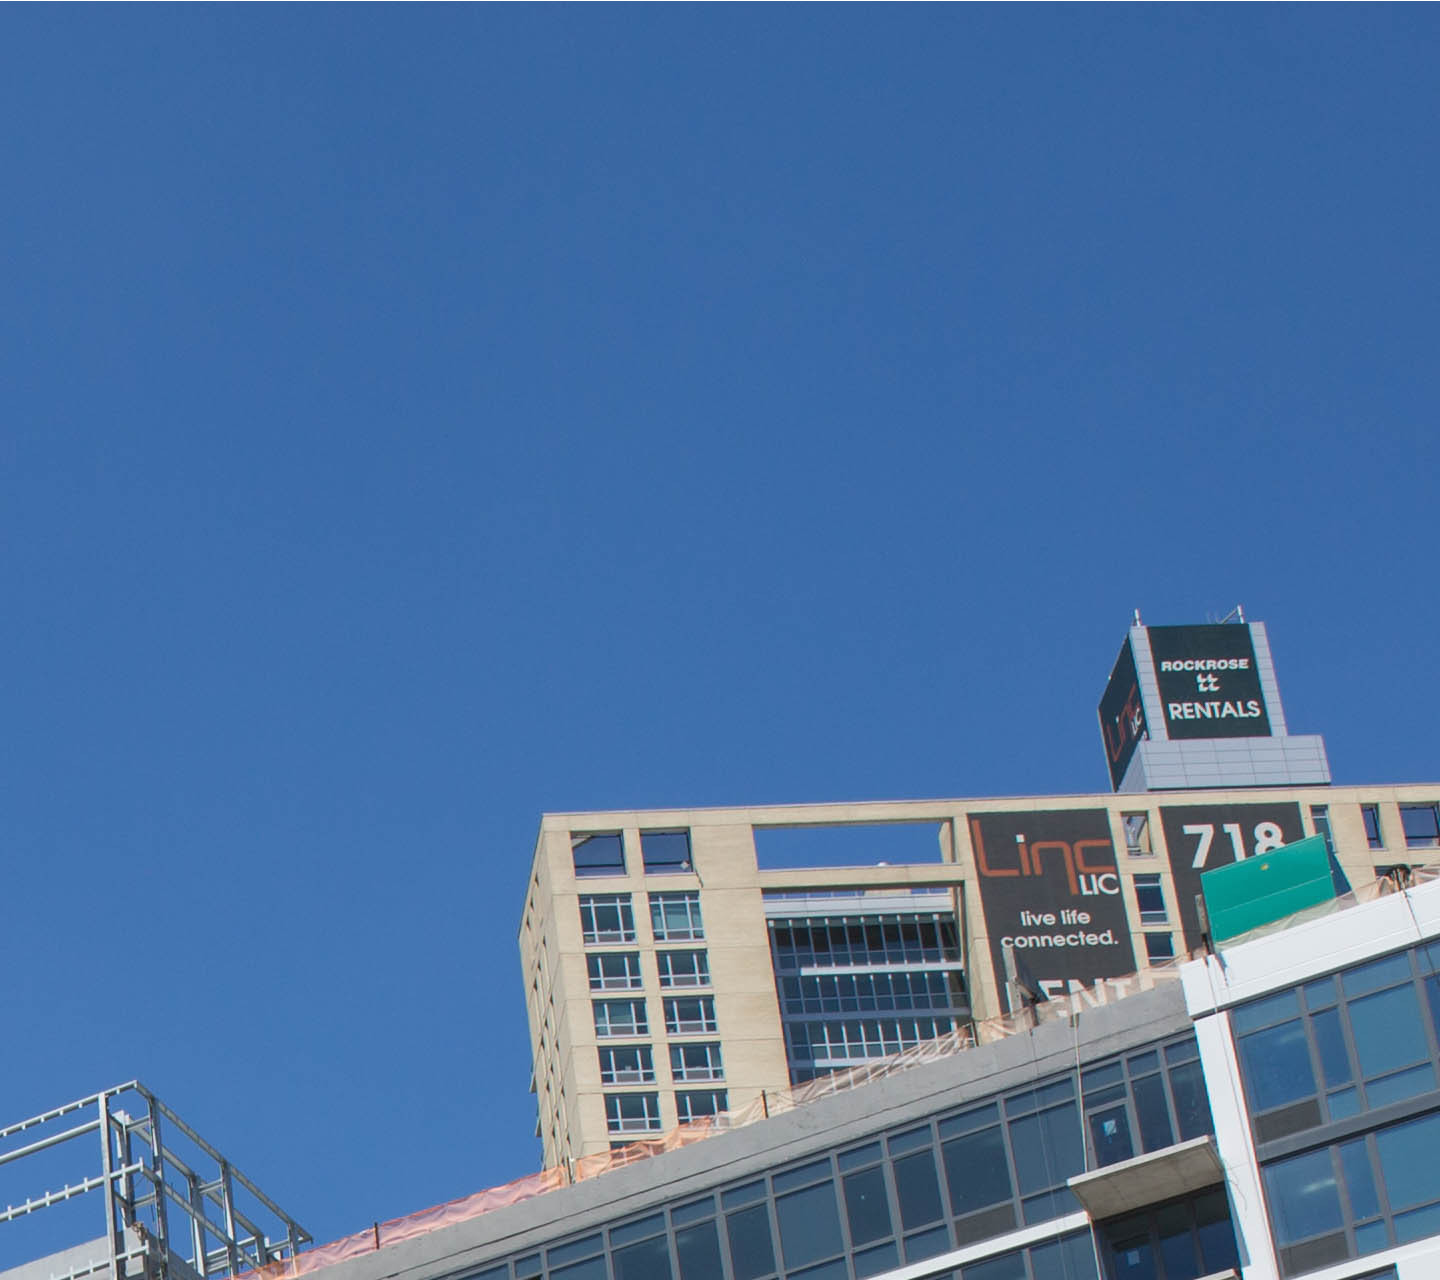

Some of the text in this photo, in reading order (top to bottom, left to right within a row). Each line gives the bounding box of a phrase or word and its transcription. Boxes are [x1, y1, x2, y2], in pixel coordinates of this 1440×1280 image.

[1161, 659, 1249, 672] ROCKROSE
[1168, 700, 1261, 720] RENTALS
[1183, 821, 1285, 869] 718
[1078, 873, 1120, 896] LIC
[1020, 909, 1091, 926] live life
[1000, 929, 1119, 948] connected.
